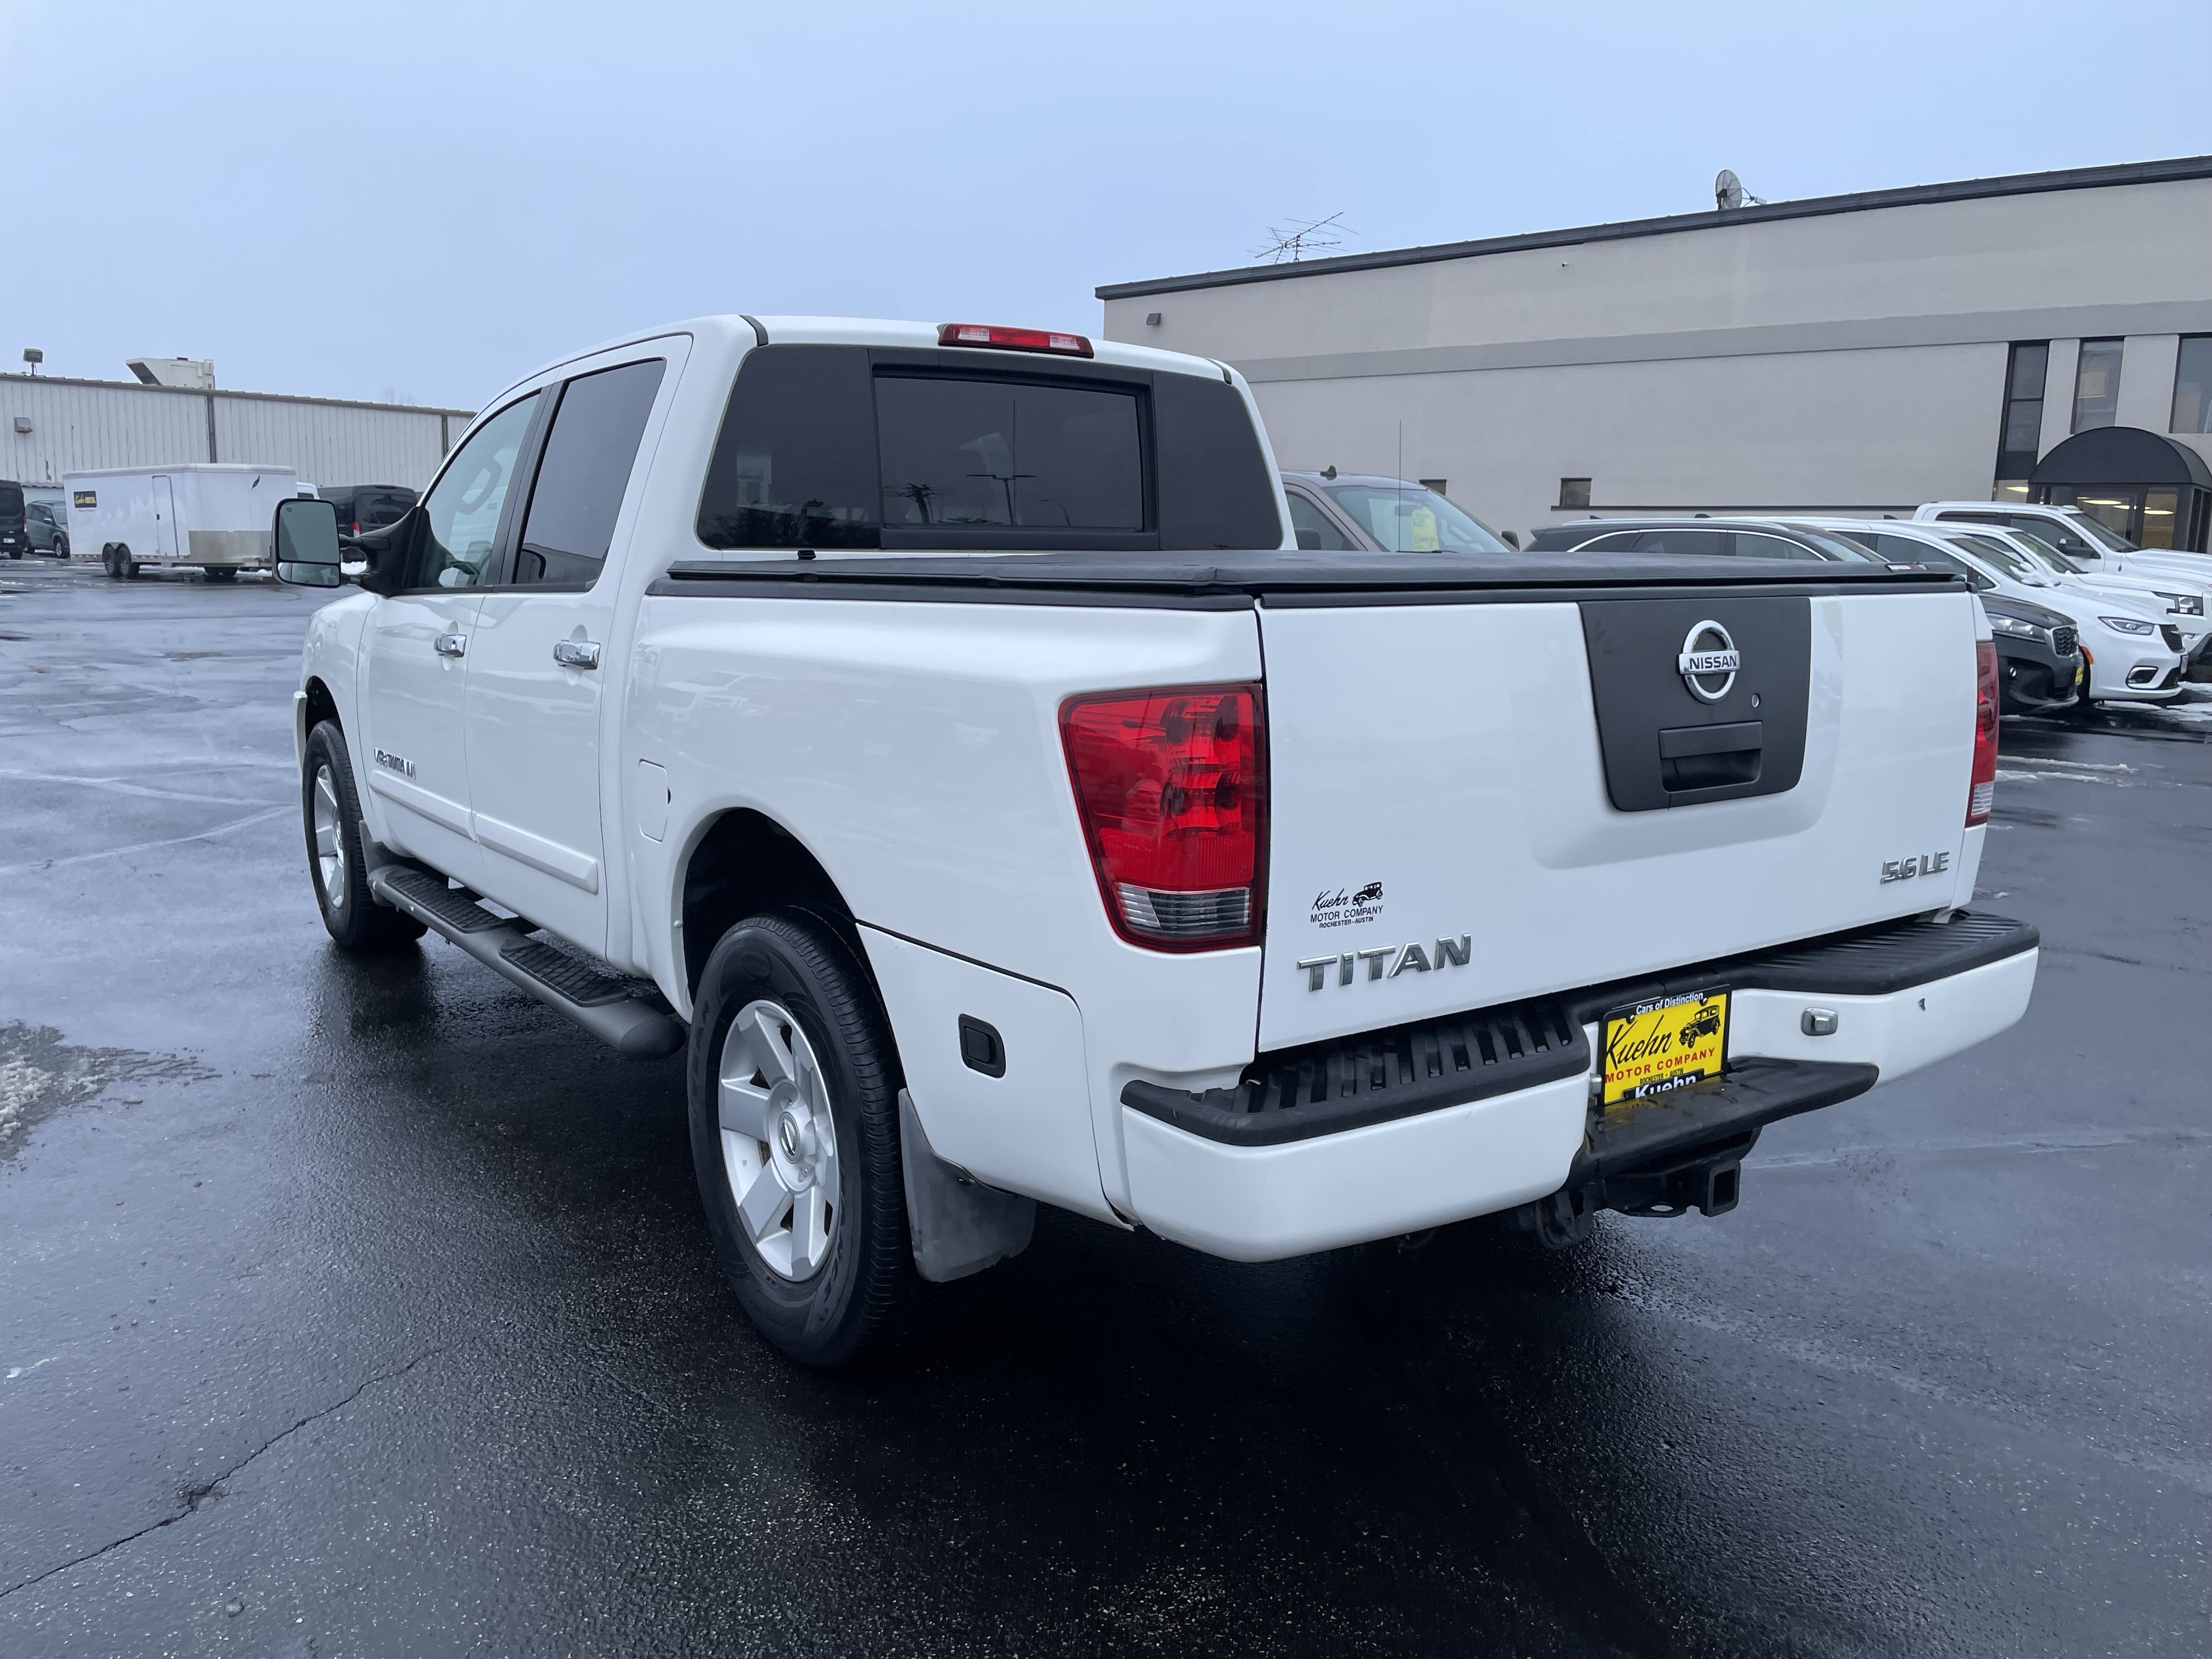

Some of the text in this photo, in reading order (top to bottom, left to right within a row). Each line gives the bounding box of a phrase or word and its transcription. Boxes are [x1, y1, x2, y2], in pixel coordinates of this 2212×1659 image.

[1690, 655, 1737, 669] NISSAN
[1918, 850, 1950, 876] LE
[1311, 888, 1348, 911] Kuehn
[1310, 905, 1384, 923] MOTOR COMPANY
[1296, 932, 1472, 992] TITAN
[1636, 992, 1703, 1015] Cars of Distinction
[1606, 1014, 1673, 1070] Kuehn
[1605, 1047, 1716, 1084] MOTOR COMPANY
